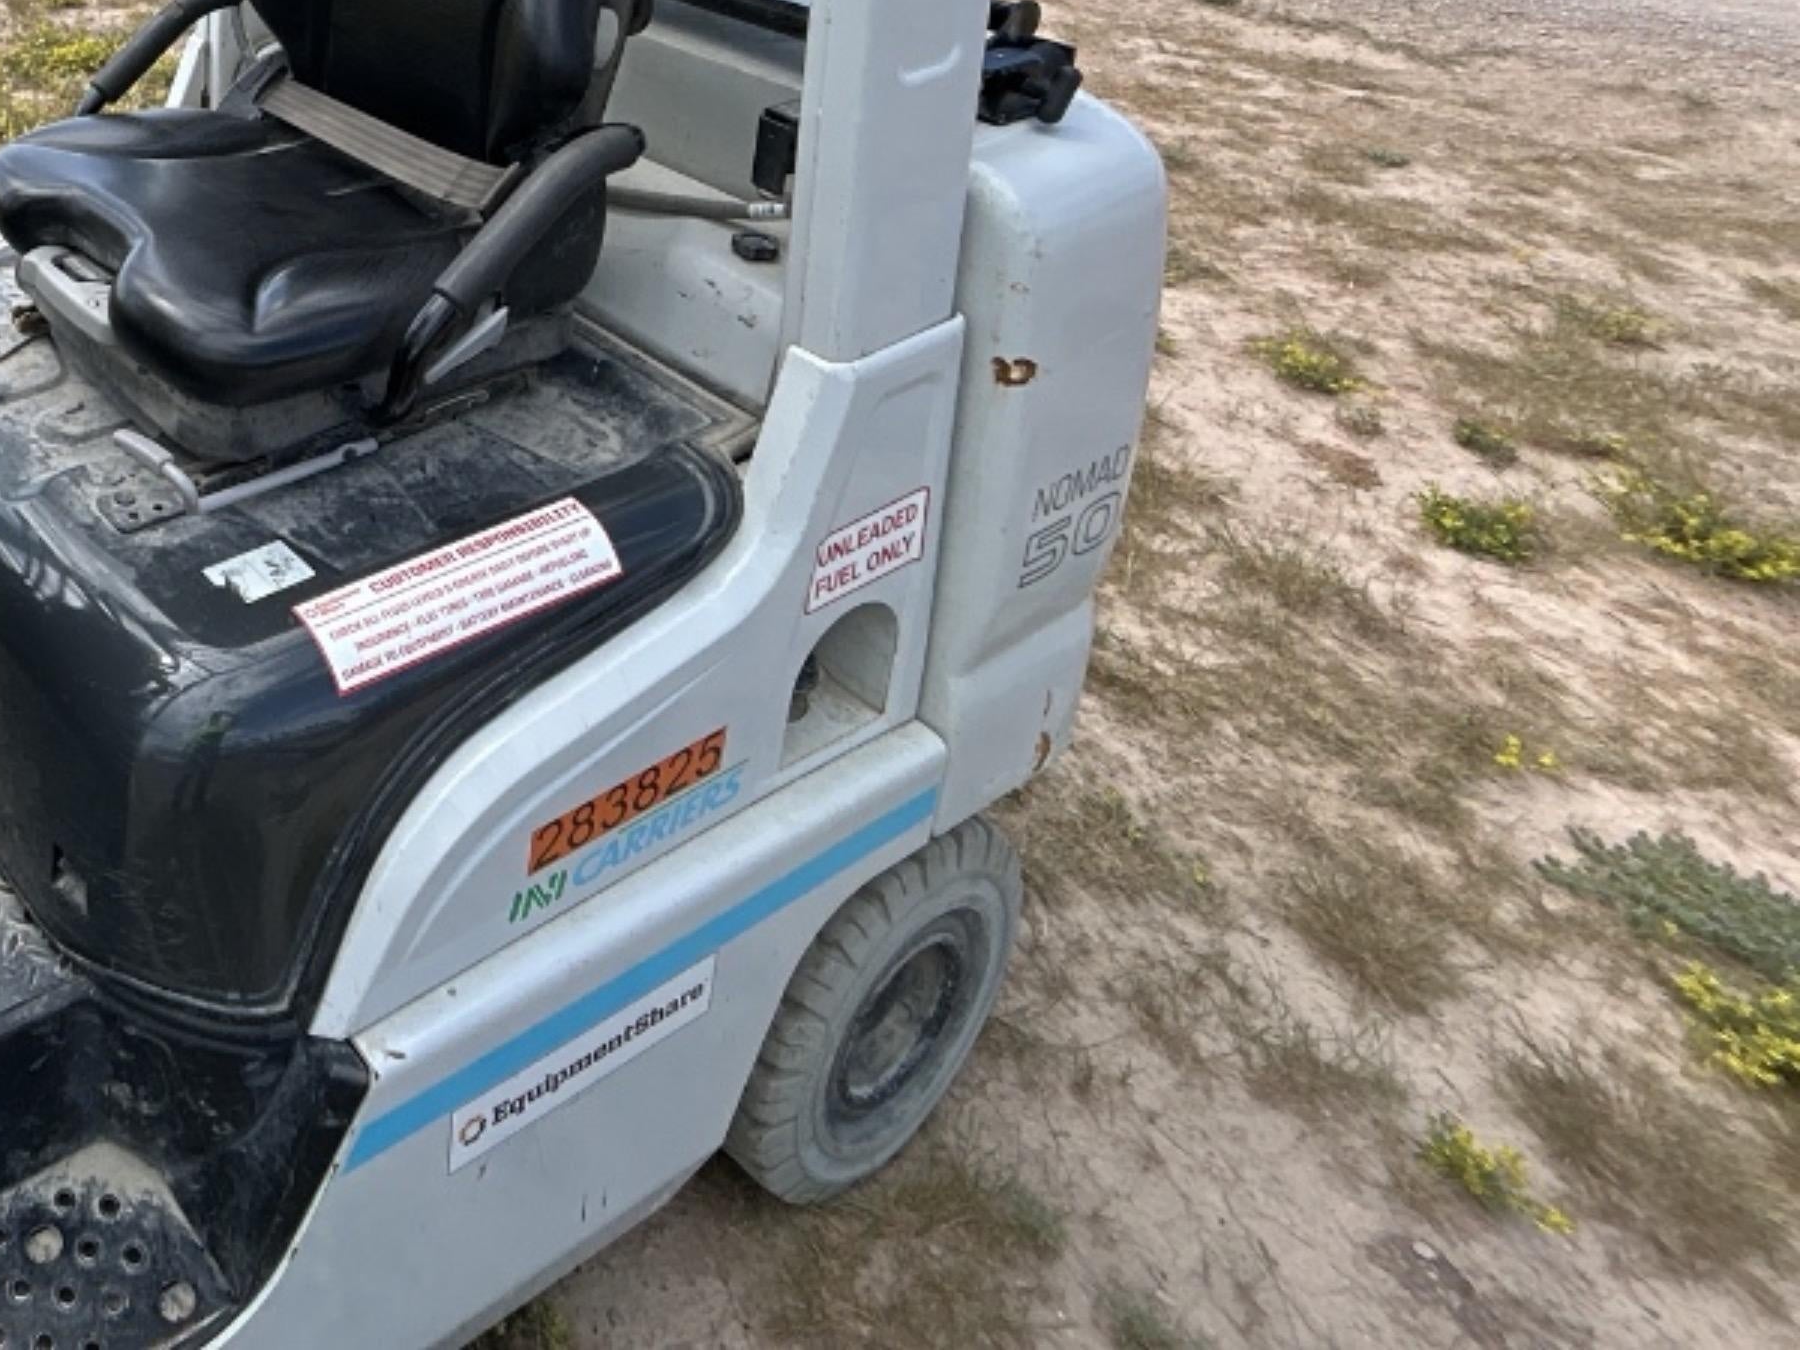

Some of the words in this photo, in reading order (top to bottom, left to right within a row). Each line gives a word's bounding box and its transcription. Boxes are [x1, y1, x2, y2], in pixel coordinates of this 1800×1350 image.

[1032, 444, 1130, 523] NOMAD
[368, 551, 457, 593] CUSTOMER
[456, 502, 581, 558] RESPONSIBILITY
[815, 562, 861, 599] FUEL
[866, 531, 916, 571] ONLY
[817, 503, 919, 568] UNLEADED
[1017, 491, 1121, 589] 50
[528, 727, 727, 875] 283825
[490, 982, 704, 1127] EquipmentShare
